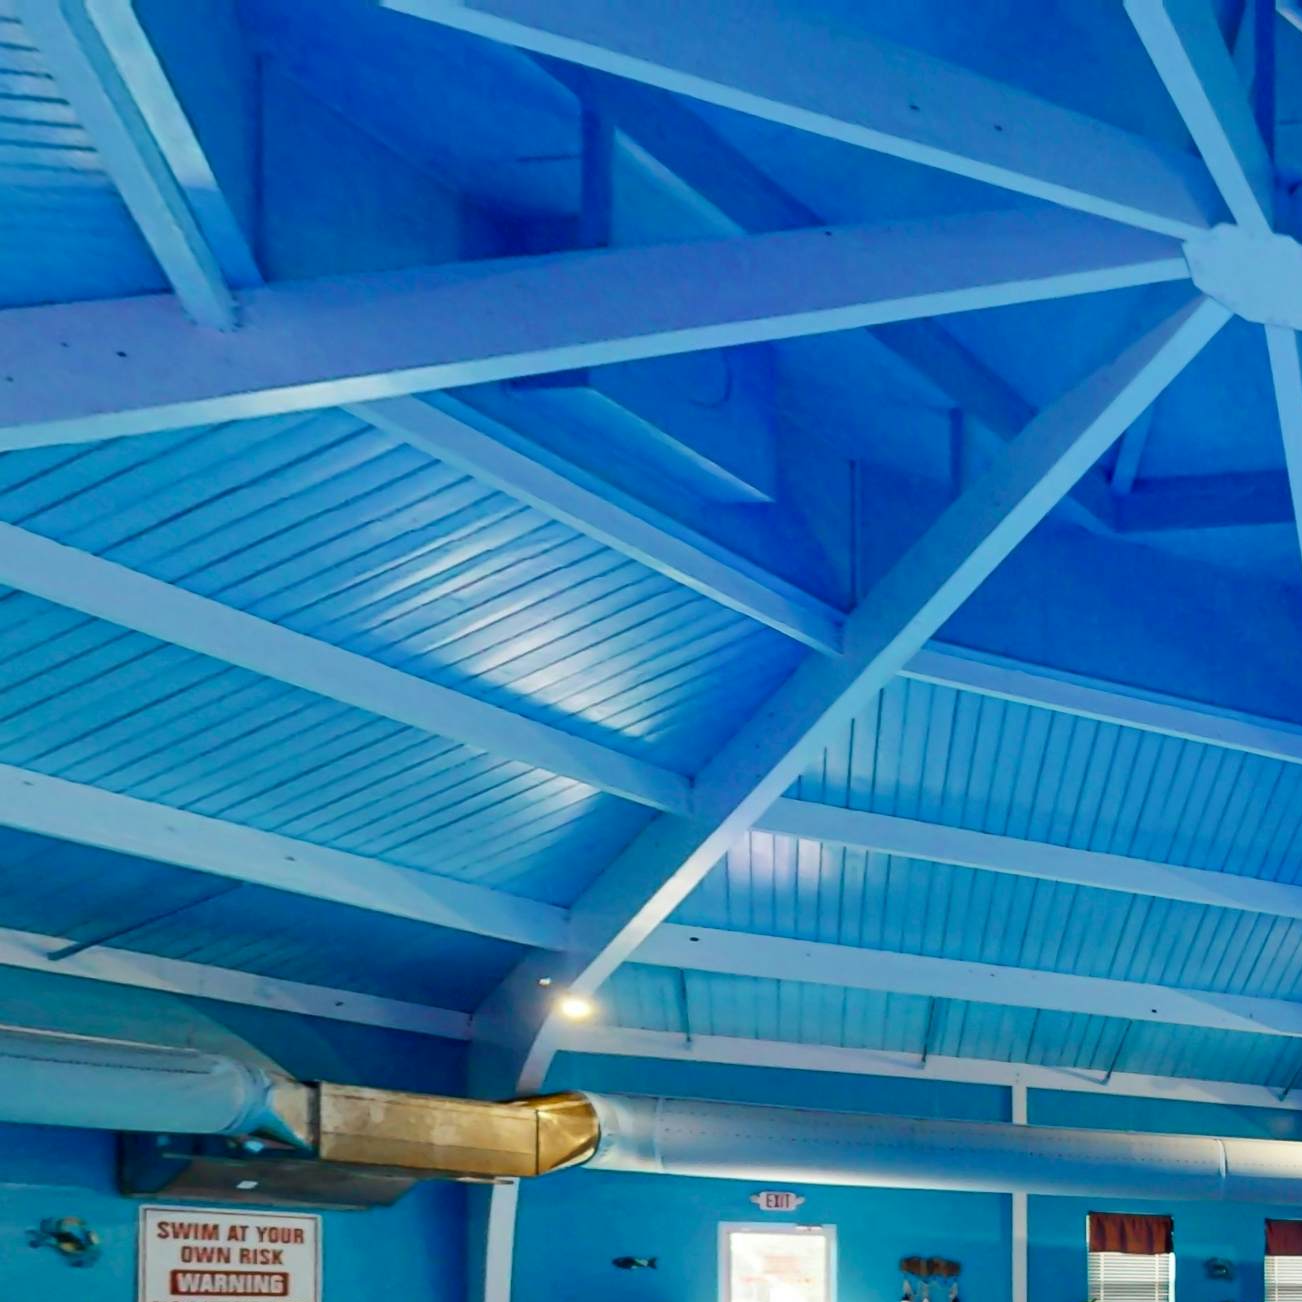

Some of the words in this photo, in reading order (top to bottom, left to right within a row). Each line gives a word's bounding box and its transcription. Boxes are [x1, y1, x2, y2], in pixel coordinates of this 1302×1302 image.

[765, 1193, 790, 1208] EXIT
[157, 1221, 220, 1240] SWIM
[227, 1225, 249, 1242] AT
[255, 1226, 305, 1244] YOUR
[180, 1246, 231, 1264] OWN
[239, 1248, 284, 1265] RISK
[175, 1272, 284, 1294] WARNING
